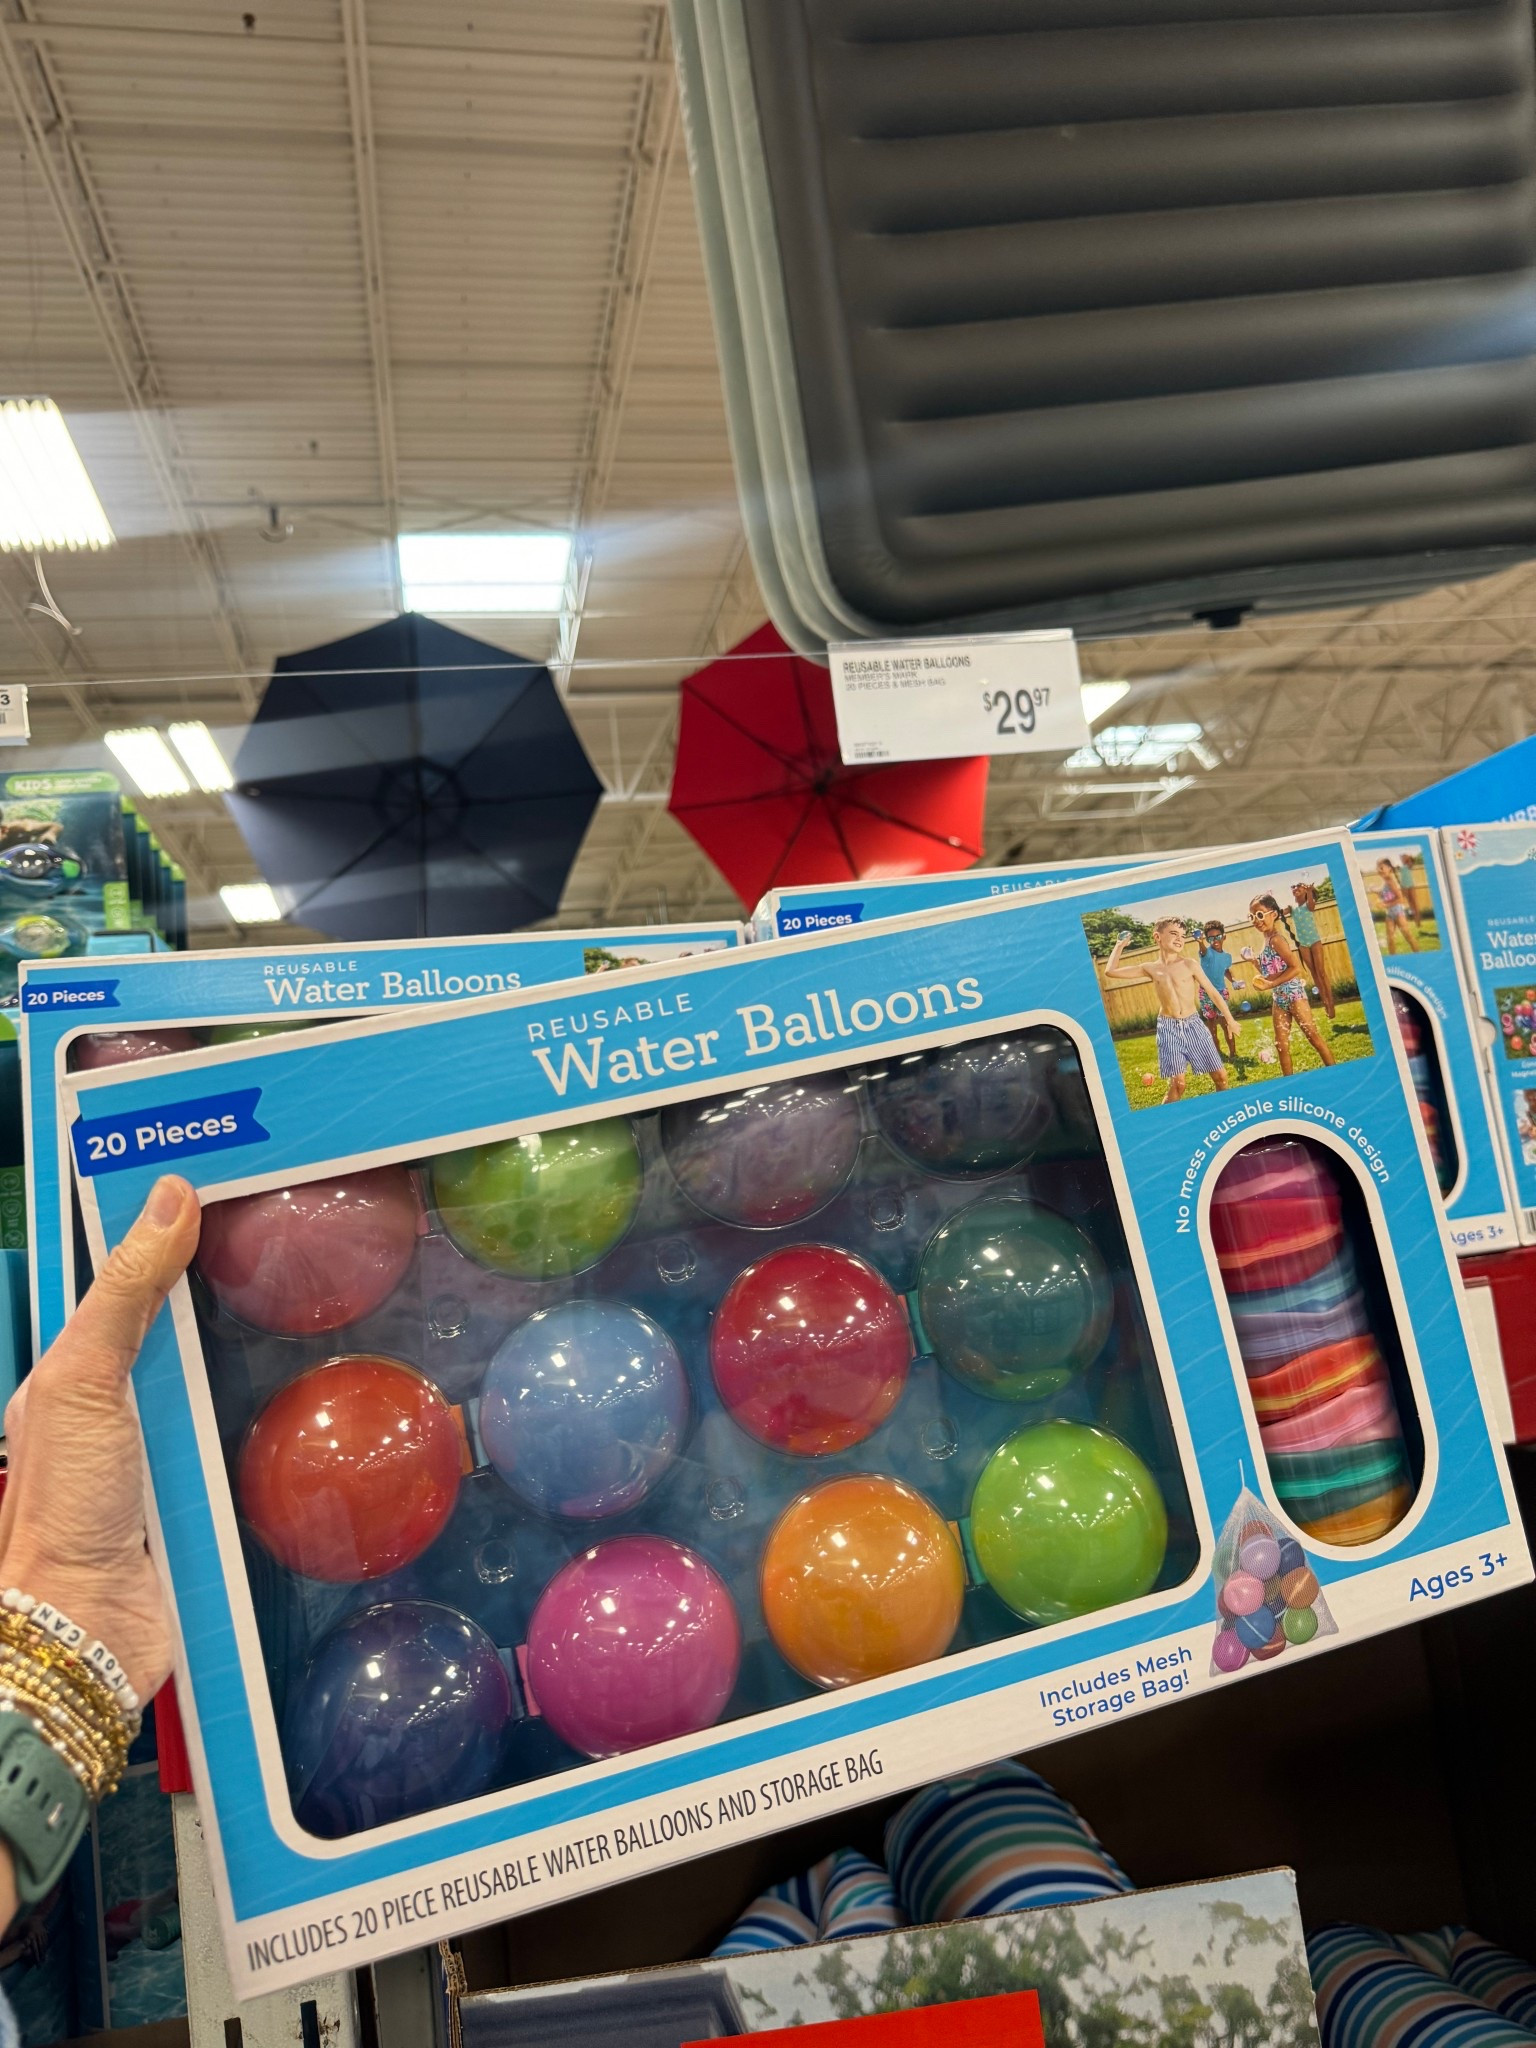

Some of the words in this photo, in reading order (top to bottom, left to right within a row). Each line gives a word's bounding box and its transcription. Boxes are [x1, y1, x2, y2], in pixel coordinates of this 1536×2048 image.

[843, 661, 891, 674] REUSABLE
[892, 659, 921, 671] WATER
[923, 656, 971, 669] BALLOONS
[14, 778, 53, 792] KIDS
[782, 918, 801, 930] 20
[804, 914, 852, 928] Pieces
[264, 960, 358, 976] REUSABLE
[264, 977, 370, 1005] Water
[381, 969, 521, 999] Balloons
[27, 993, 48, 1006] 20
[52, 989, 106, 1004] Pieces
[1386, 965, 1425, 988] silicone
[1424, 985, 1449, 1020] design
[528, 993, 693, 1042] REUSABLE
[532, 1028, 719, 1096] Water
[736, 977, 983, 1056] Balloons
[1203, 1098, 1274, 1148] reusable
[1279, 1096, 1346, 1129] silicone
[86, 1132, 127, 1161] 20
[136, 1114, 238, 1151] Pieces
[1348, 1126, 1390, 1184] design
[1179, 1148, 1206, 1199] mess
[1175, 1205, 1190, 1233] No
[1487, 1225, 1504, 1238] 3+
[1410, 1565, 1473, 1601] Ages
[1479, 1552, 1508, 1577] 3+
[39, 1606, 81, 1642] CAN
[93, 1647, 124, 1688] YOU
[1039, 1667, 1131, 1707] Includes
[1136, 1646, 1192, 1677] Mesh
[1053, 1690, 1135, 1727] Storage
[1142, 1669, 1189, 1698] Bag!
[247, 1915, 348, 1971] INCLUDES
[351, 1907, 378, 1939] 20
[382, 1887, 438, 1930] PIECE
[441, 1855, 541, 1911] REUSABLE
[544, 1834, 611, 1878] WATER
[613, 1802, 713, 1856] BALLOONS
[717, 1789, 757, 1824] AND
[760, 1761, 843, 1811] STORAGE
[845, 1749, 883, 1784] BAG
